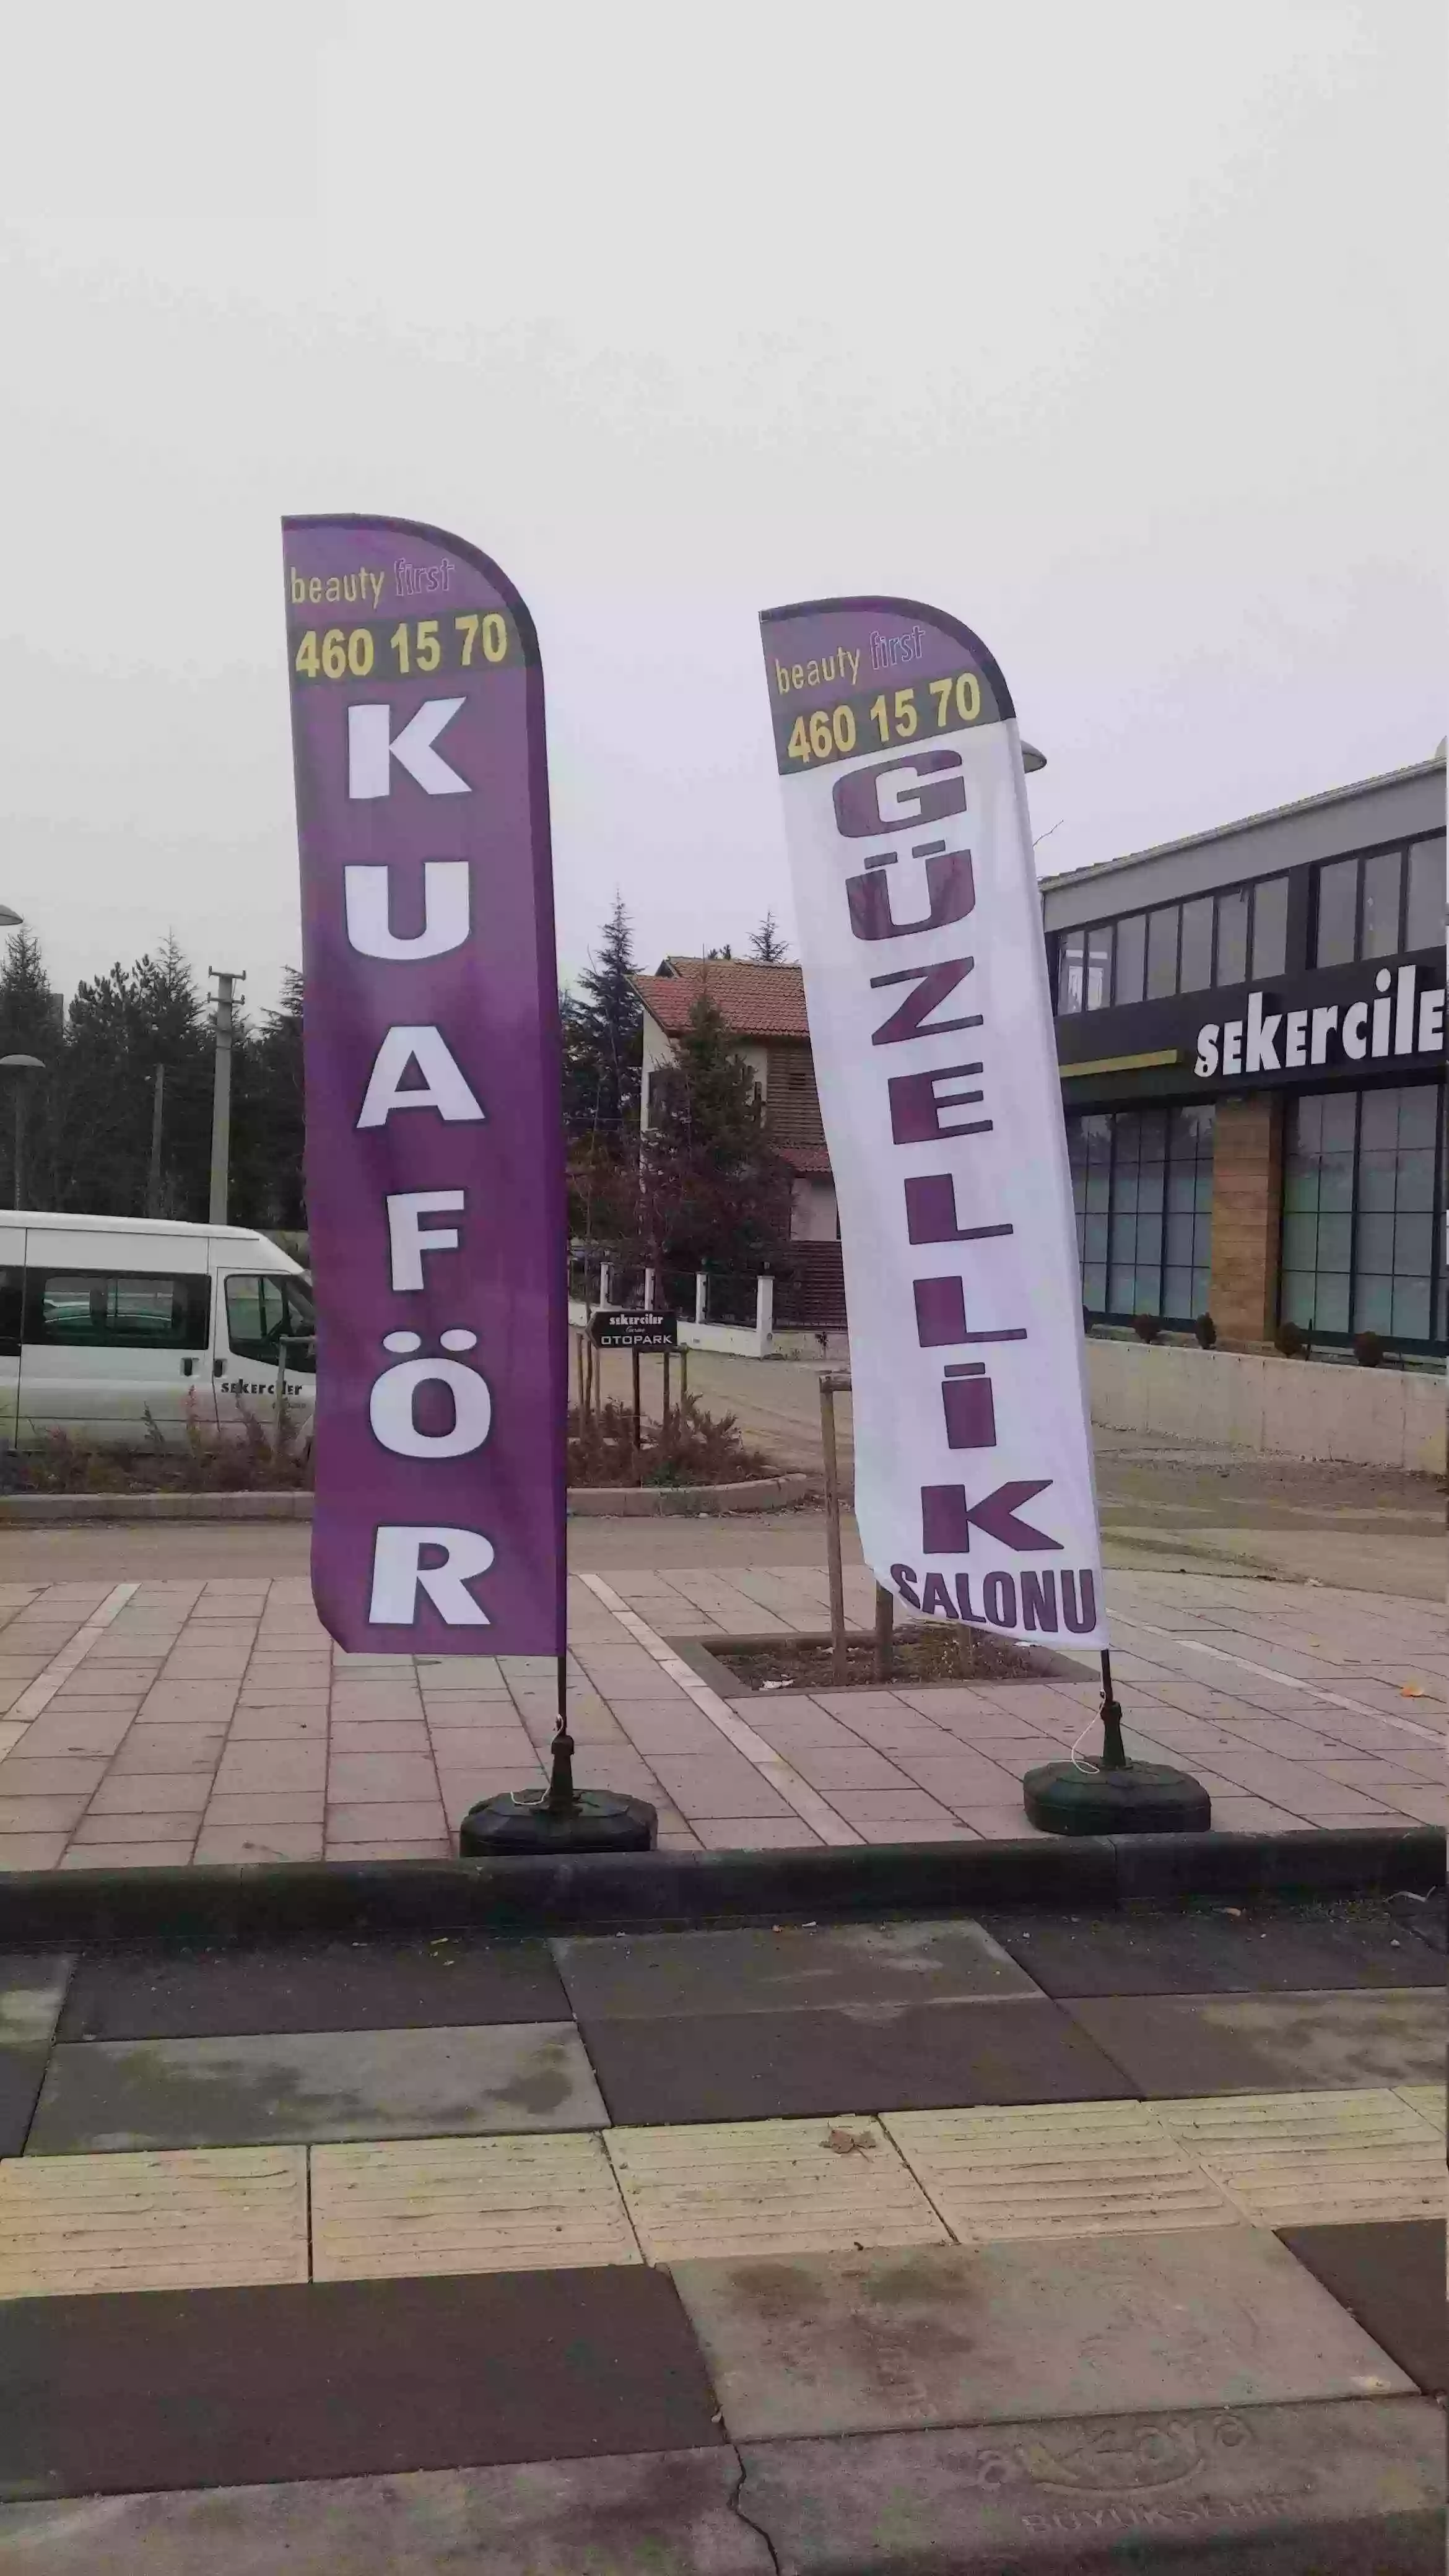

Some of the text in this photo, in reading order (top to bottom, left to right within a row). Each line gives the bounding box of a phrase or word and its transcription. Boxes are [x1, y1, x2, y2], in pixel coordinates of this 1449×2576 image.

[290, 558, 455, 609] beauty first
[295, 614, 507, 678] 460 15 70
[775, 625, 925, 695] beauty first
[787, 672, 980, 763] 460 15 70
[344, 696, 495, 1625] KUAFÖR
[601, 1334, 673, 1345] OTOPARK
[890, 1563, 1097, 1634] SALONU
